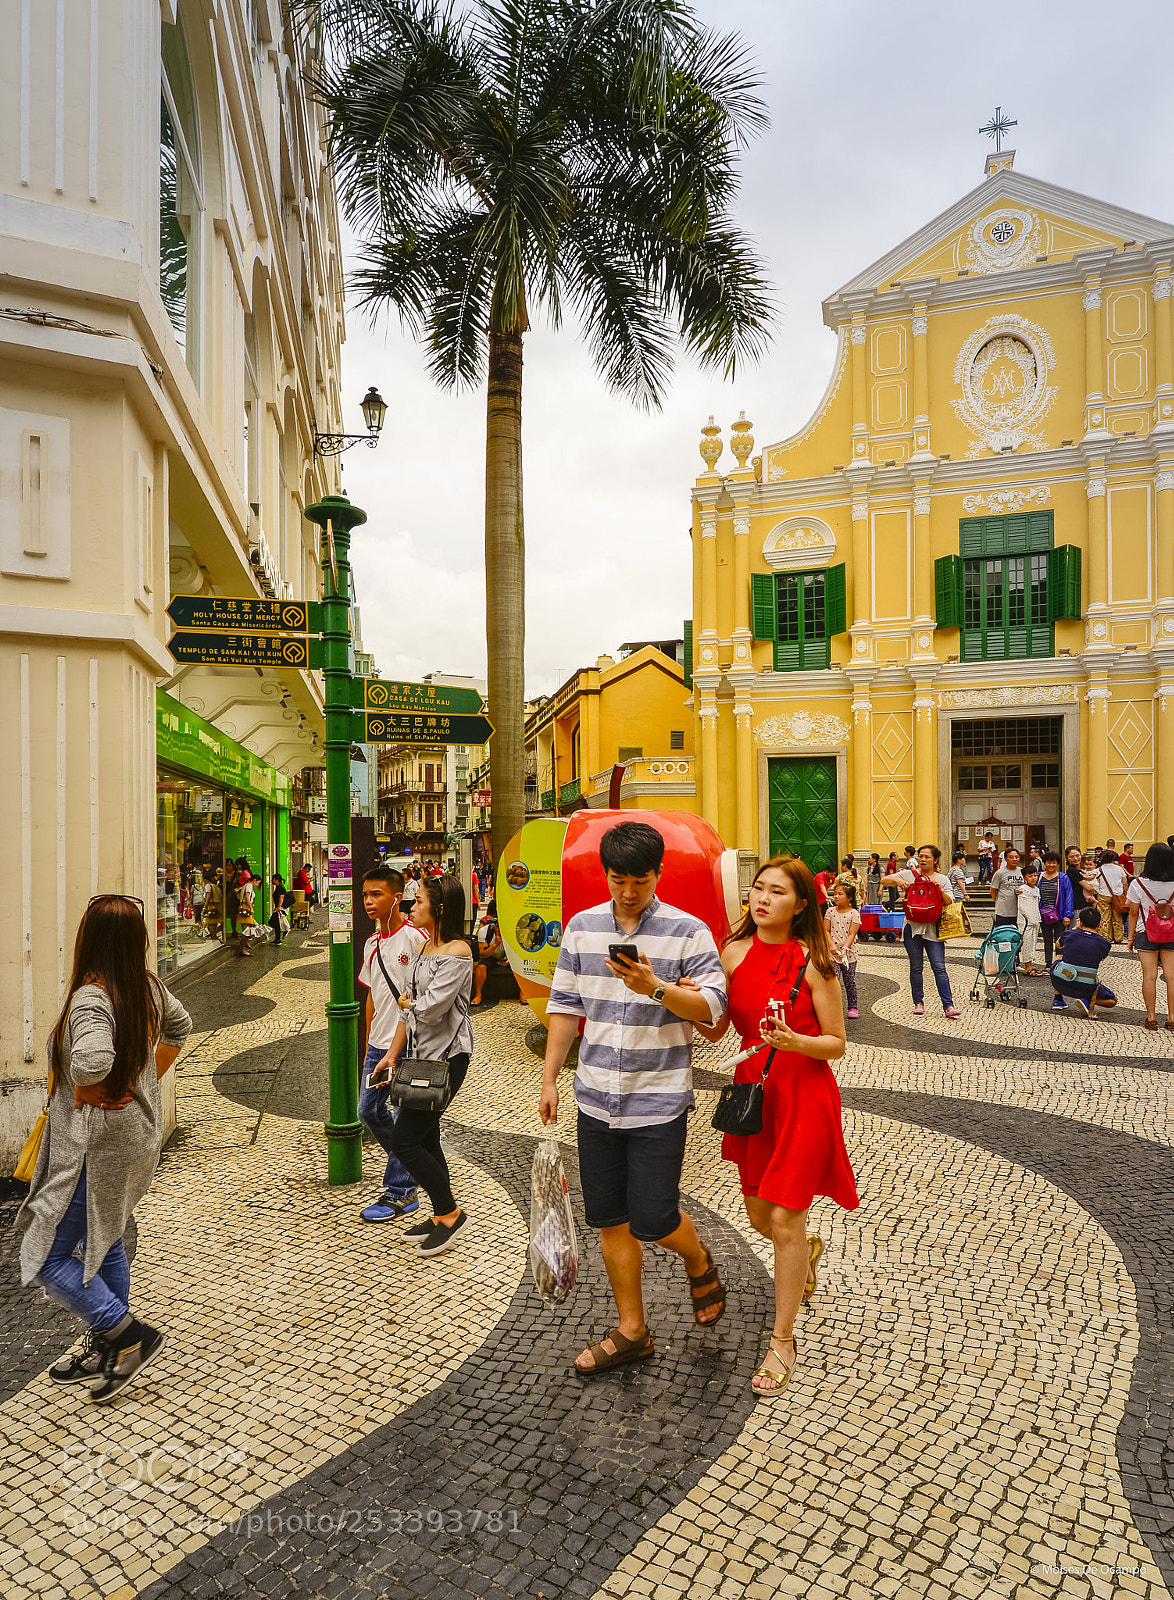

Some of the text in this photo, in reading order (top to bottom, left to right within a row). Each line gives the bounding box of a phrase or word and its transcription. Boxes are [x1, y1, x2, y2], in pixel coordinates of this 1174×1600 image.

[212, 600, 281, 614] 仁慈堂大樓
[228, 637, 282, 649] 三街會館
[387, 716, 450, 728] 大三巴牌坊
